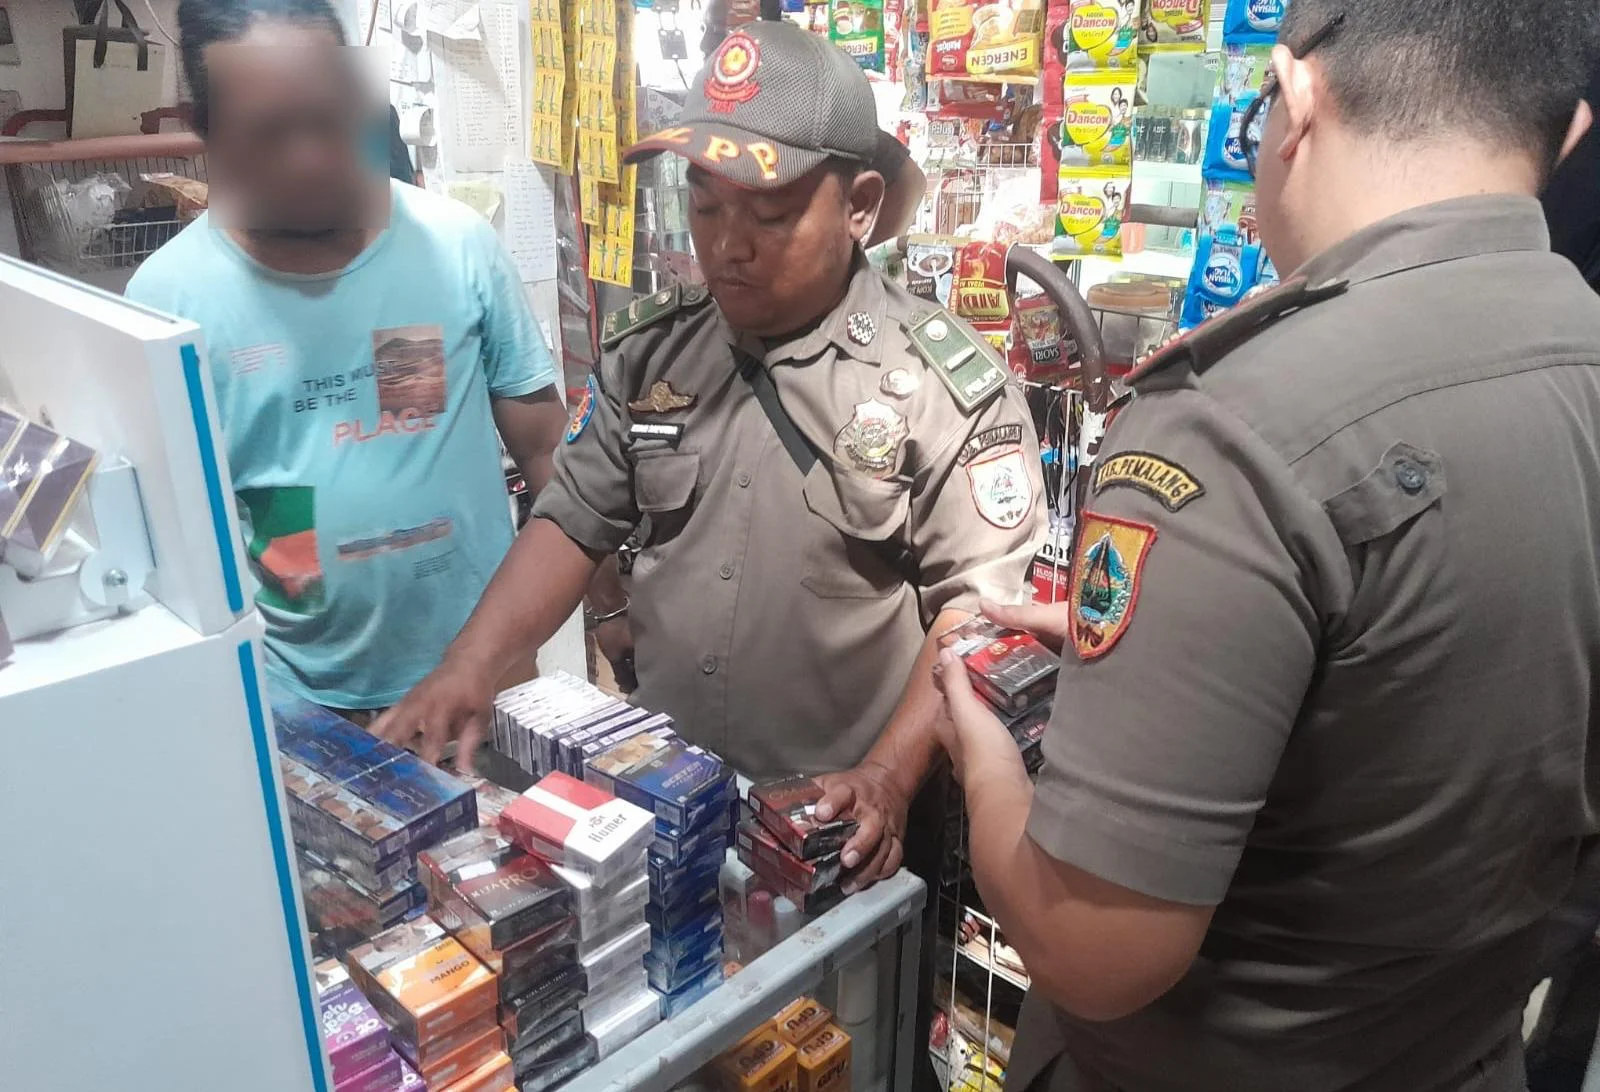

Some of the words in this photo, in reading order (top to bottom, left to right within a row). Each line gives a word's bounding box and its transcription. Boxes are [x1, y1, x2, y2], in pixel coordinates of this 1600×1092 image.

[1072, 15, 1116, 29] Dancow
[971, 47, 1028, 67] ENERGEN
[1067, 110, 1109, 124] Dancow
[1061, 202, 1103, 216] Dancow
[1034, 346, 1060, 361] SAORI
[303, 374, 345, 393] THIS
[294, 396, 318, 413] BE
[324, 388, 357, 407] THE
[334, 410, 436, 446] PLACE
[1120, 458, 1188, 498] PEMALANG
[588, 812, 627, 843] Humer
[430, 959, 470, 985] MANGO
